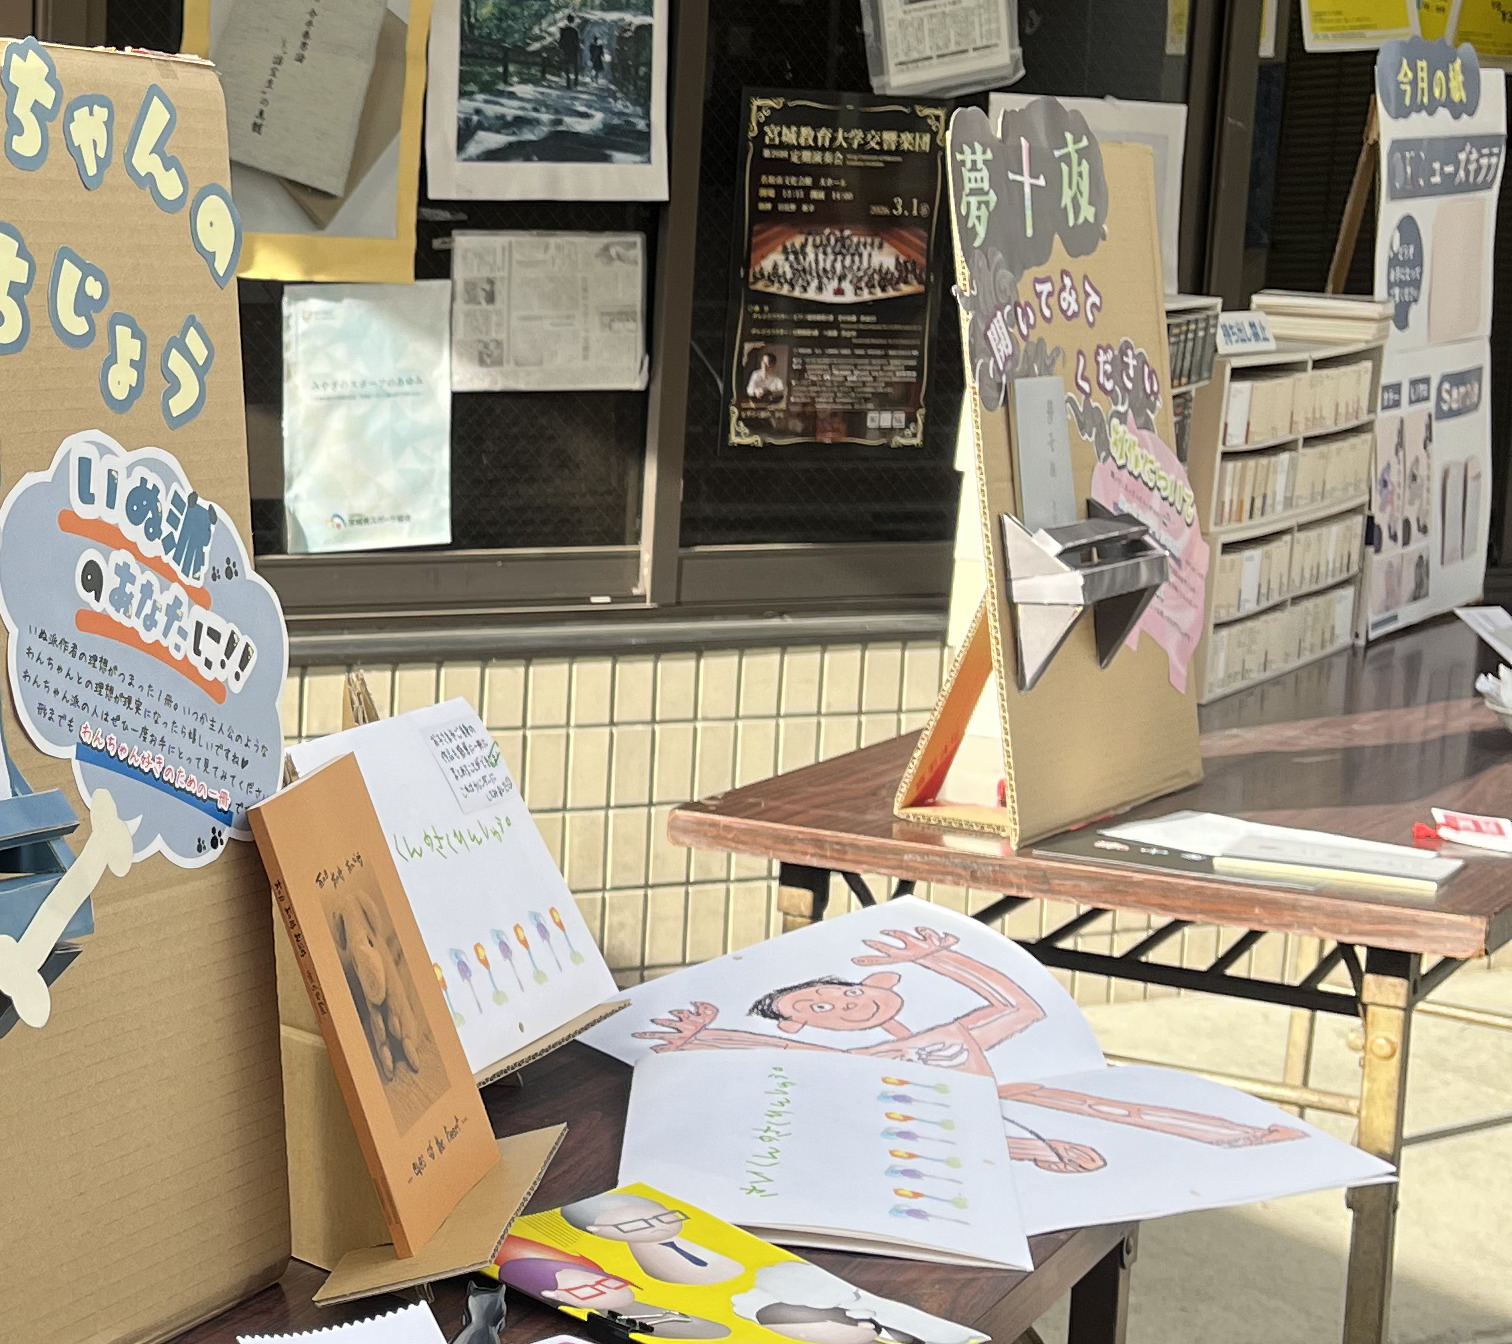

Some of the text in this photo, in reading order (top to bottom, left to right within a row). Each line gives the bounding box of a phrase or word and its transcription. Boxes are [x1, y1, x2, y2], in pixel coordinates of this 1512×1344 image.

[763, 124, 932, 153] 宮城教育大学交響楽団
[955, 131, 1097, 248] 夢十夜
[985, 269, 1103, 372] 開いてみて
[1075, 342, 1160, 399] ください
[73, 454, 218, 581] いぬ派
[80, 558, 255, 684] のあなたに!!
